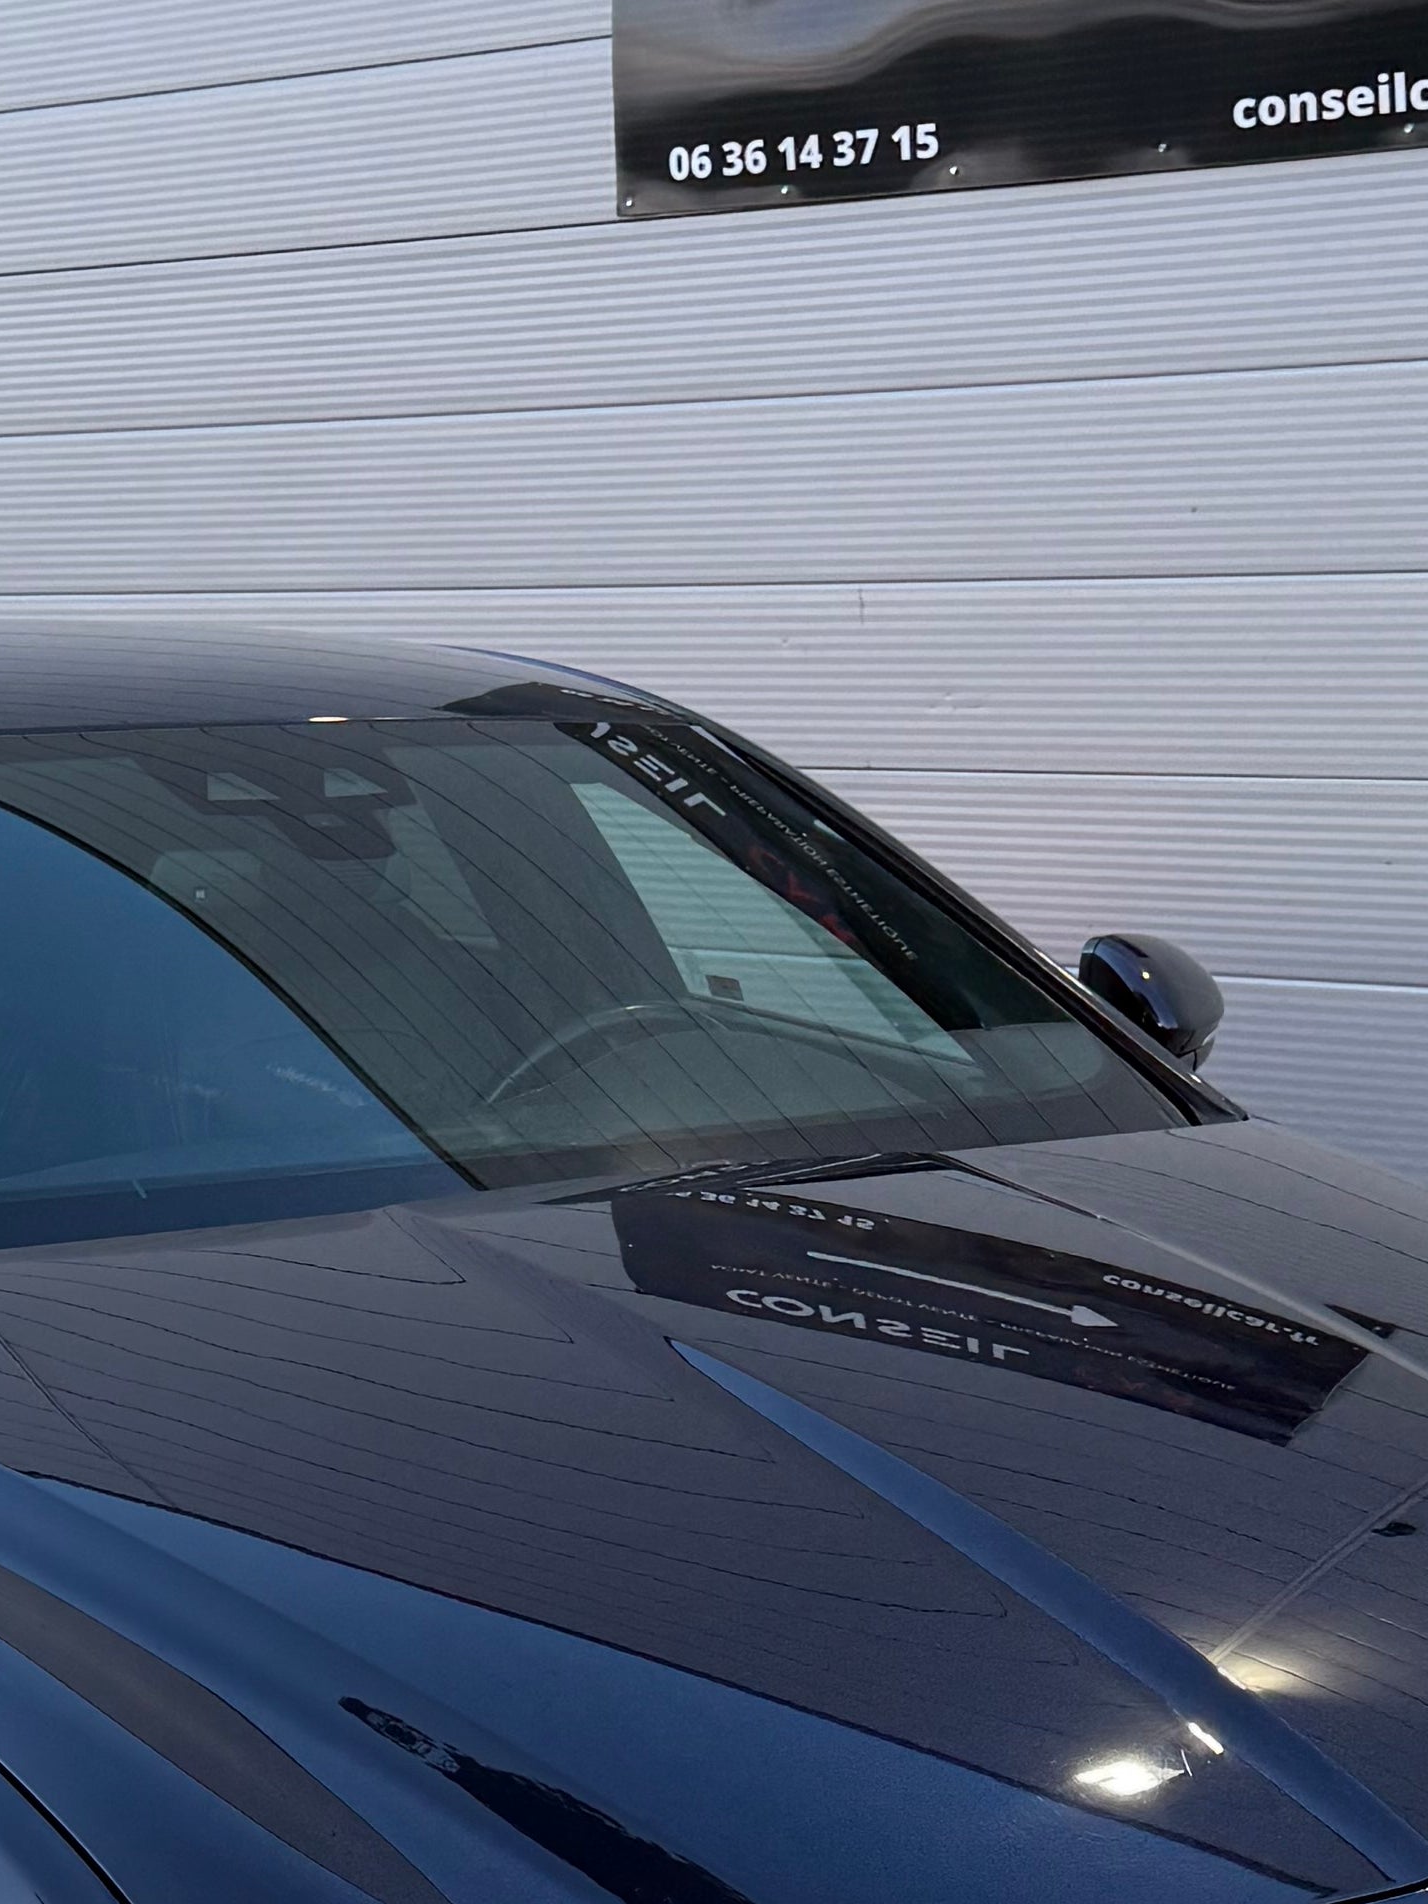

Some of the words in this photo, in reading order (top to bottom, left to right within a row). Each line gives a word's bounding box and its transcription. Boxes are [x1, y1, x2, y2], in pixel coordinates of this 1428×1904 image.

[668, 143, 713, 181] 06
[721, 139, 768, 177] 36
[777, 134, 823, 171] 14
[832, 128, 879, 167] 37
[891, 122, 939, 161] 15
